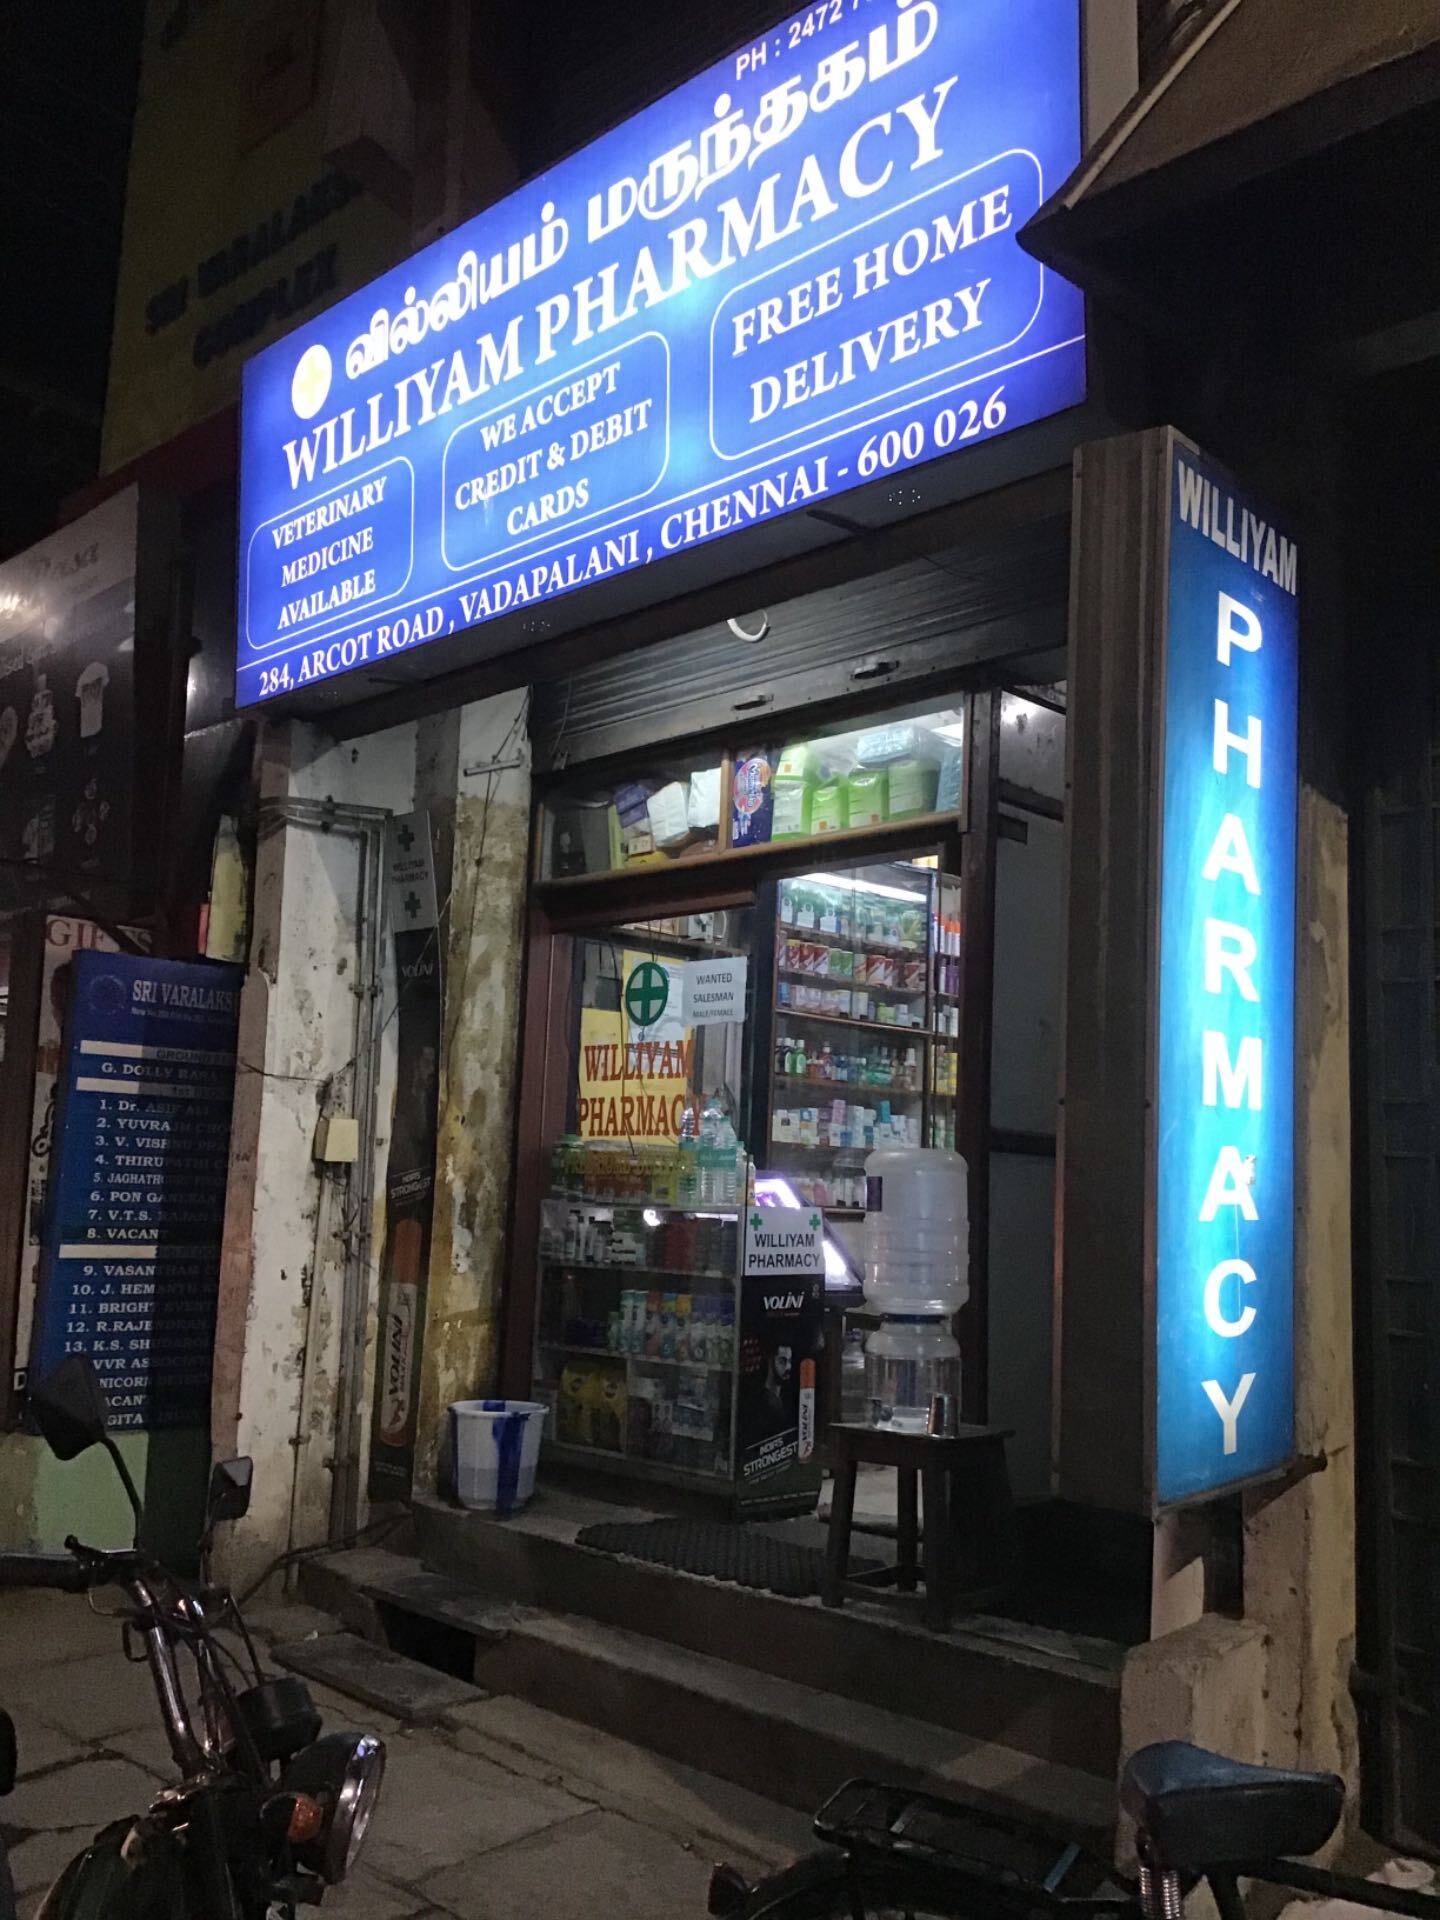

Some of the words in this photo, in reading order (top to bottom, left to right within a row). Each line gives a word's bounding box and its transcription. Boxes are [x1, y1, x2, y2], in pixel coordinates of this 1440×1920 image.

[736, 40, 767, 81] PH
[788, 0, 843, 49] 2472
[345, 201, 569, 380] வில்லியம்
[587, 0, 938, 243] மருந்தகம்
[282, 315, 524, 490] WILLIYAM
[534, 75, 959, 366] PHARMACY
[732, 267, 843, 357] FREE
[852, 184, 1012, 299] HOME
[749, 278, 991, 424] DELIVERY
[479, 413, 517, 451] WE
[519, 361, 621, 435] ACCEPT
[455, 449, 543, 511] CREDIT
[546, 442, 566, 470] &
[570, 398, 652, 462] DEBIT
[271, 476, 387, 549] VETERINARY
[506, 478, 589, 535] CARDS
[1178, 459, 1298, 596] WILLIYAM
[258, 663, 294, 696] 284,
[299, 632, 373, 680] ARCOT
[660, 456, 829, 549] CHENNAI
[857, 421, 924, 476] 600
[933, 385, 1007, 448] 026
[281, 526, 374, 587] MEDICINE
[277, 569, 376, 630] AVAILABLE
[132, 979, 158, 1003] SRI
[693, 992, 734, 1003] SALESMAN
[696, 972, 733, 985] WANTED
[1199, 590, 1264, 1456] PHARMACY
[122, 1064, 175, 1078] DOLLY
[584, 1039, 694, 1082] WILLIYAM
[577, 1093, 708, 1137] PHARMACY
[110, 1191, 142, 1203] PON
[748, 1253, 821, 1268] PHARMACY
[754, 1233, 815, 1248] WILLIYAM
[68, 1302, 93, 1315] 11.
[72, 1284, 95, 1295] 10.
[64, 1340, 88, 1352] 13.
[65, 1321, 90, 1333] 12.
[92, 1358, 126, 1370] VVR
[743, 1440, 798, 1477] STRONGEST
